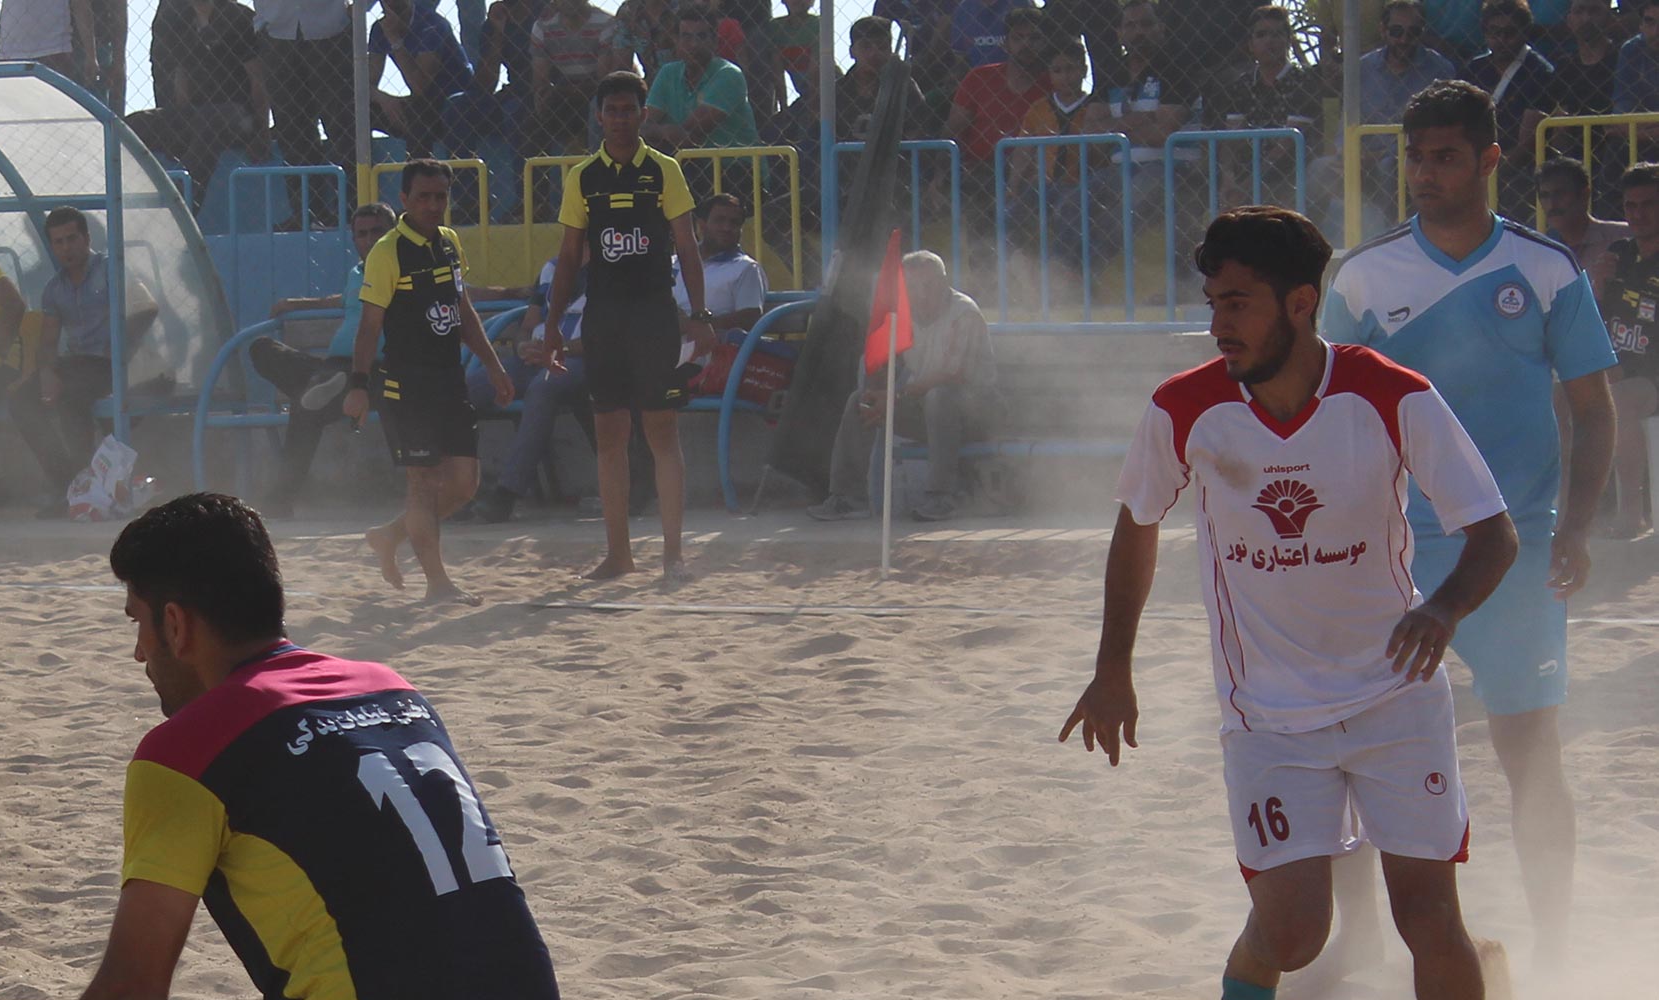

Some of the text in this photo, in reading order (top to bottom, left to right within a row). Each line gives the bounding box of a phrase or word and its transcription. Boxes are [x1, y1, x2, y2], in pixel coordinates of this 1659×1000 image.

[1263, 463, 1311, 474] uhlsport
[1226, 536, 1367, 573] موسسه اعتباری نور
[338, 703, 392, 731] قطعات
[392, 698, 438, 728] پخش
[356, 741, 515, 896] 12
[1247, 796, 1291, 848] 16
